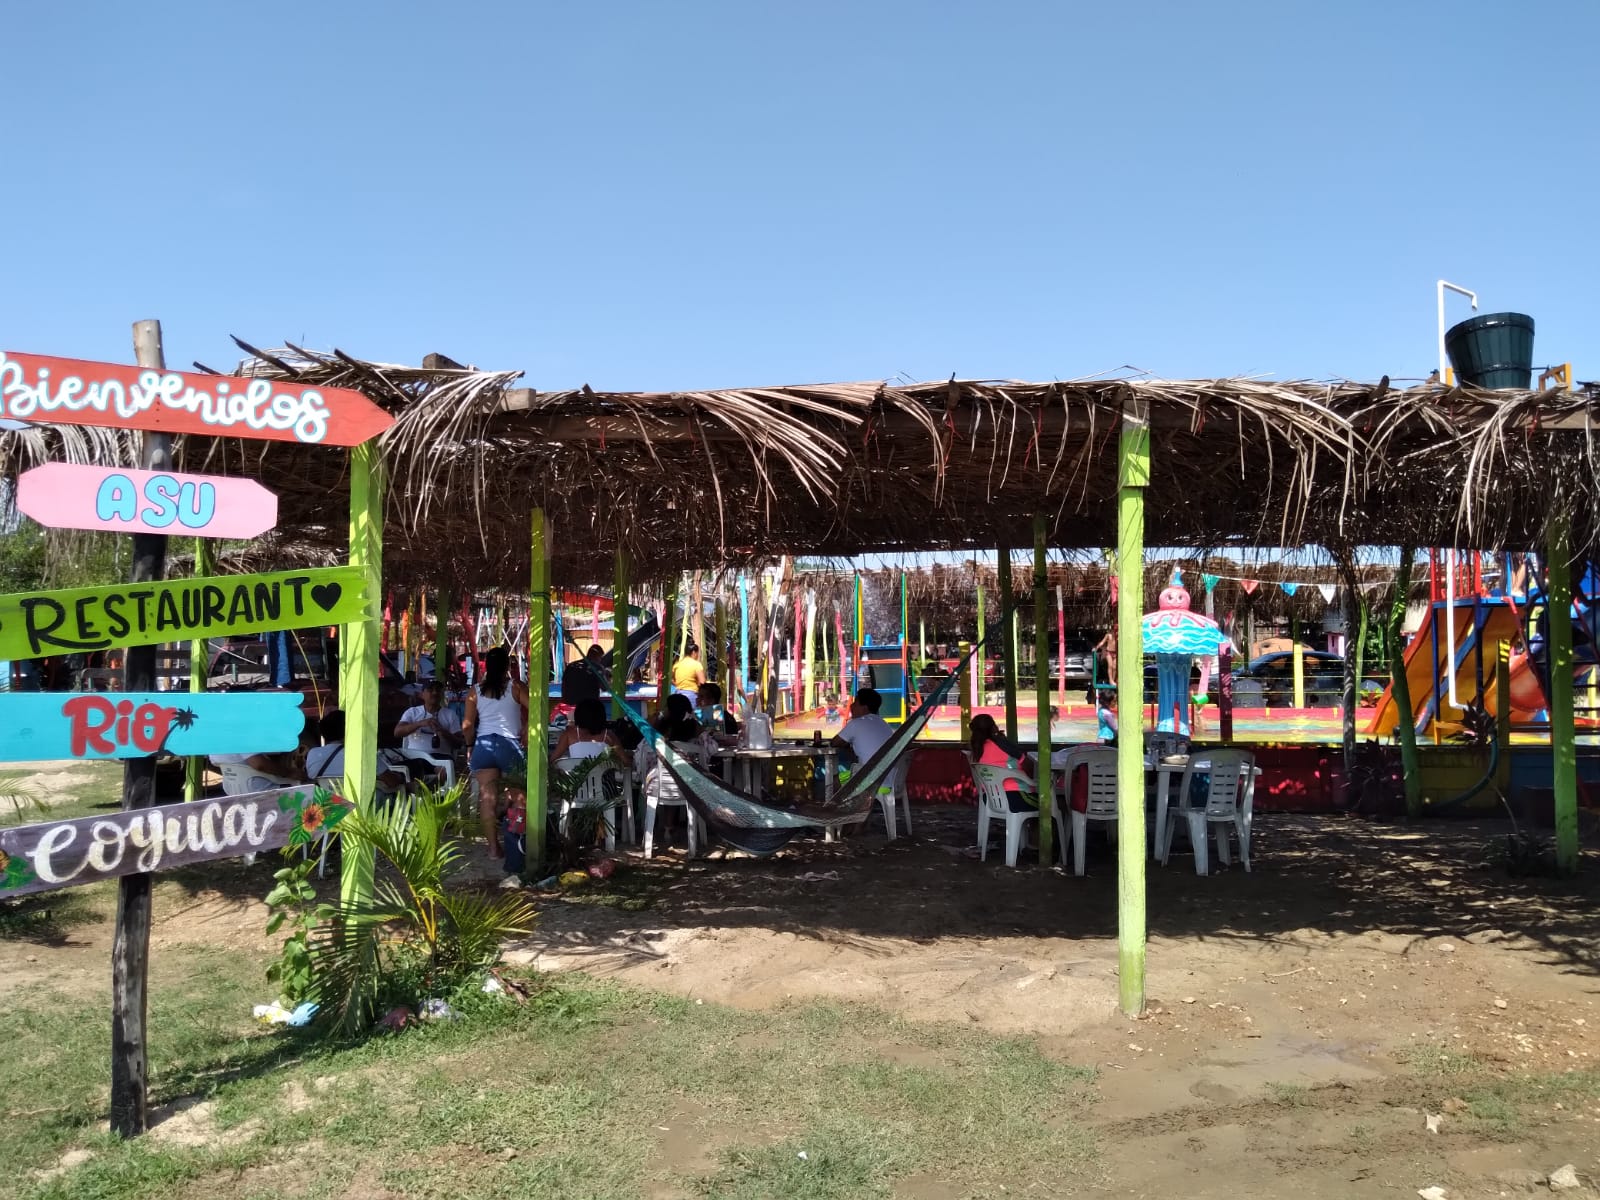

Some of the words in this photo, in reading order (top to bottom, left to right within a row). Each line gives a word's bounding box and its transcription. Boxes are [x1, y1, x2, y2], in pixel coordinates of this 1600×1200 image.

[0, 351, 330, 444] Bienvenidos
[20, 577, 310, 654] RESTAURANT
[62, 695, 177, 757] Rio
[25, 802, 278, 884] Coyuca
